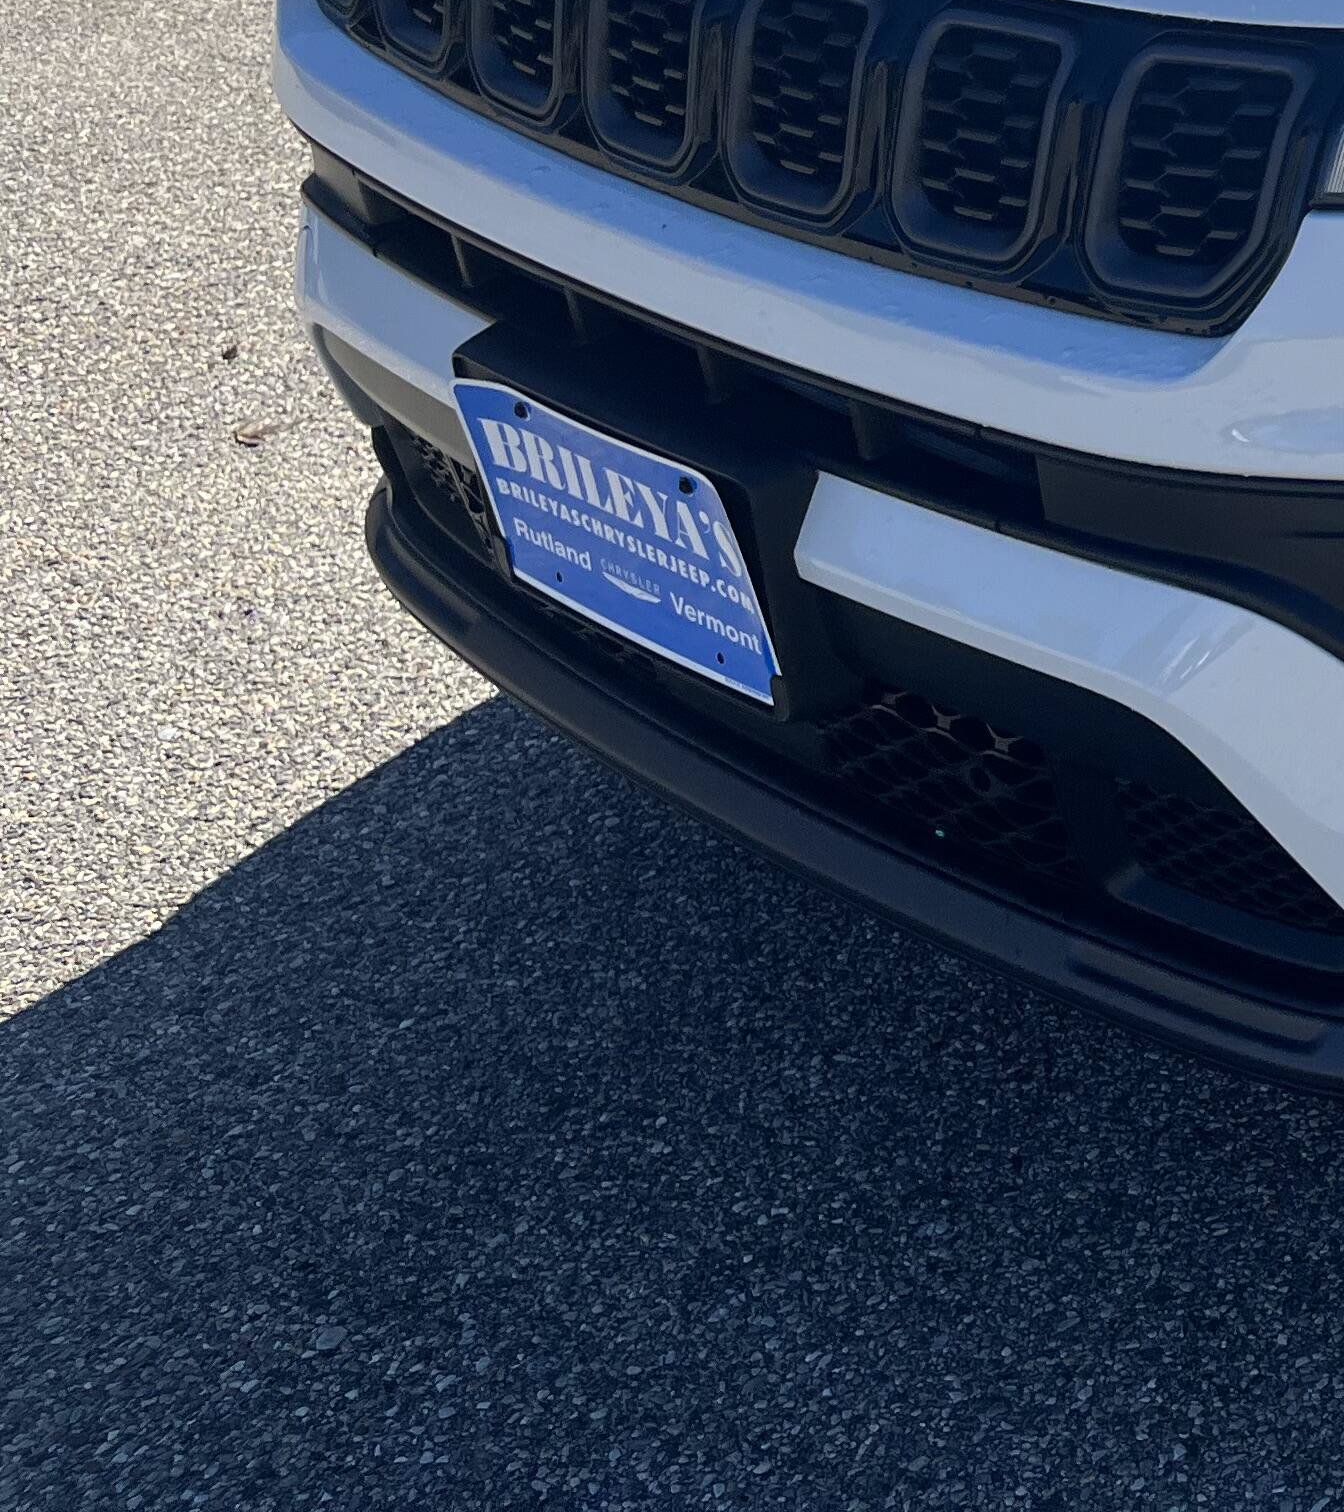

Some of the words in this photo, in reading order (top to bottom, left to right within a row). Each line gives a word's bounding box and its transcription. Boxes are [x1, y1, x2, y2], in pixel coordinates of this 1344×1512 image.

[478, 418, 742, 578] BRILEYA'S
[496, 487, 755, 615] BRILEYASCHRYSLERJEEP.COM
[513, 516, 593, 572] Rutland
[600, 558, 661, 596] CHRYSLER
[670, 591, 763, 656] Vermont
